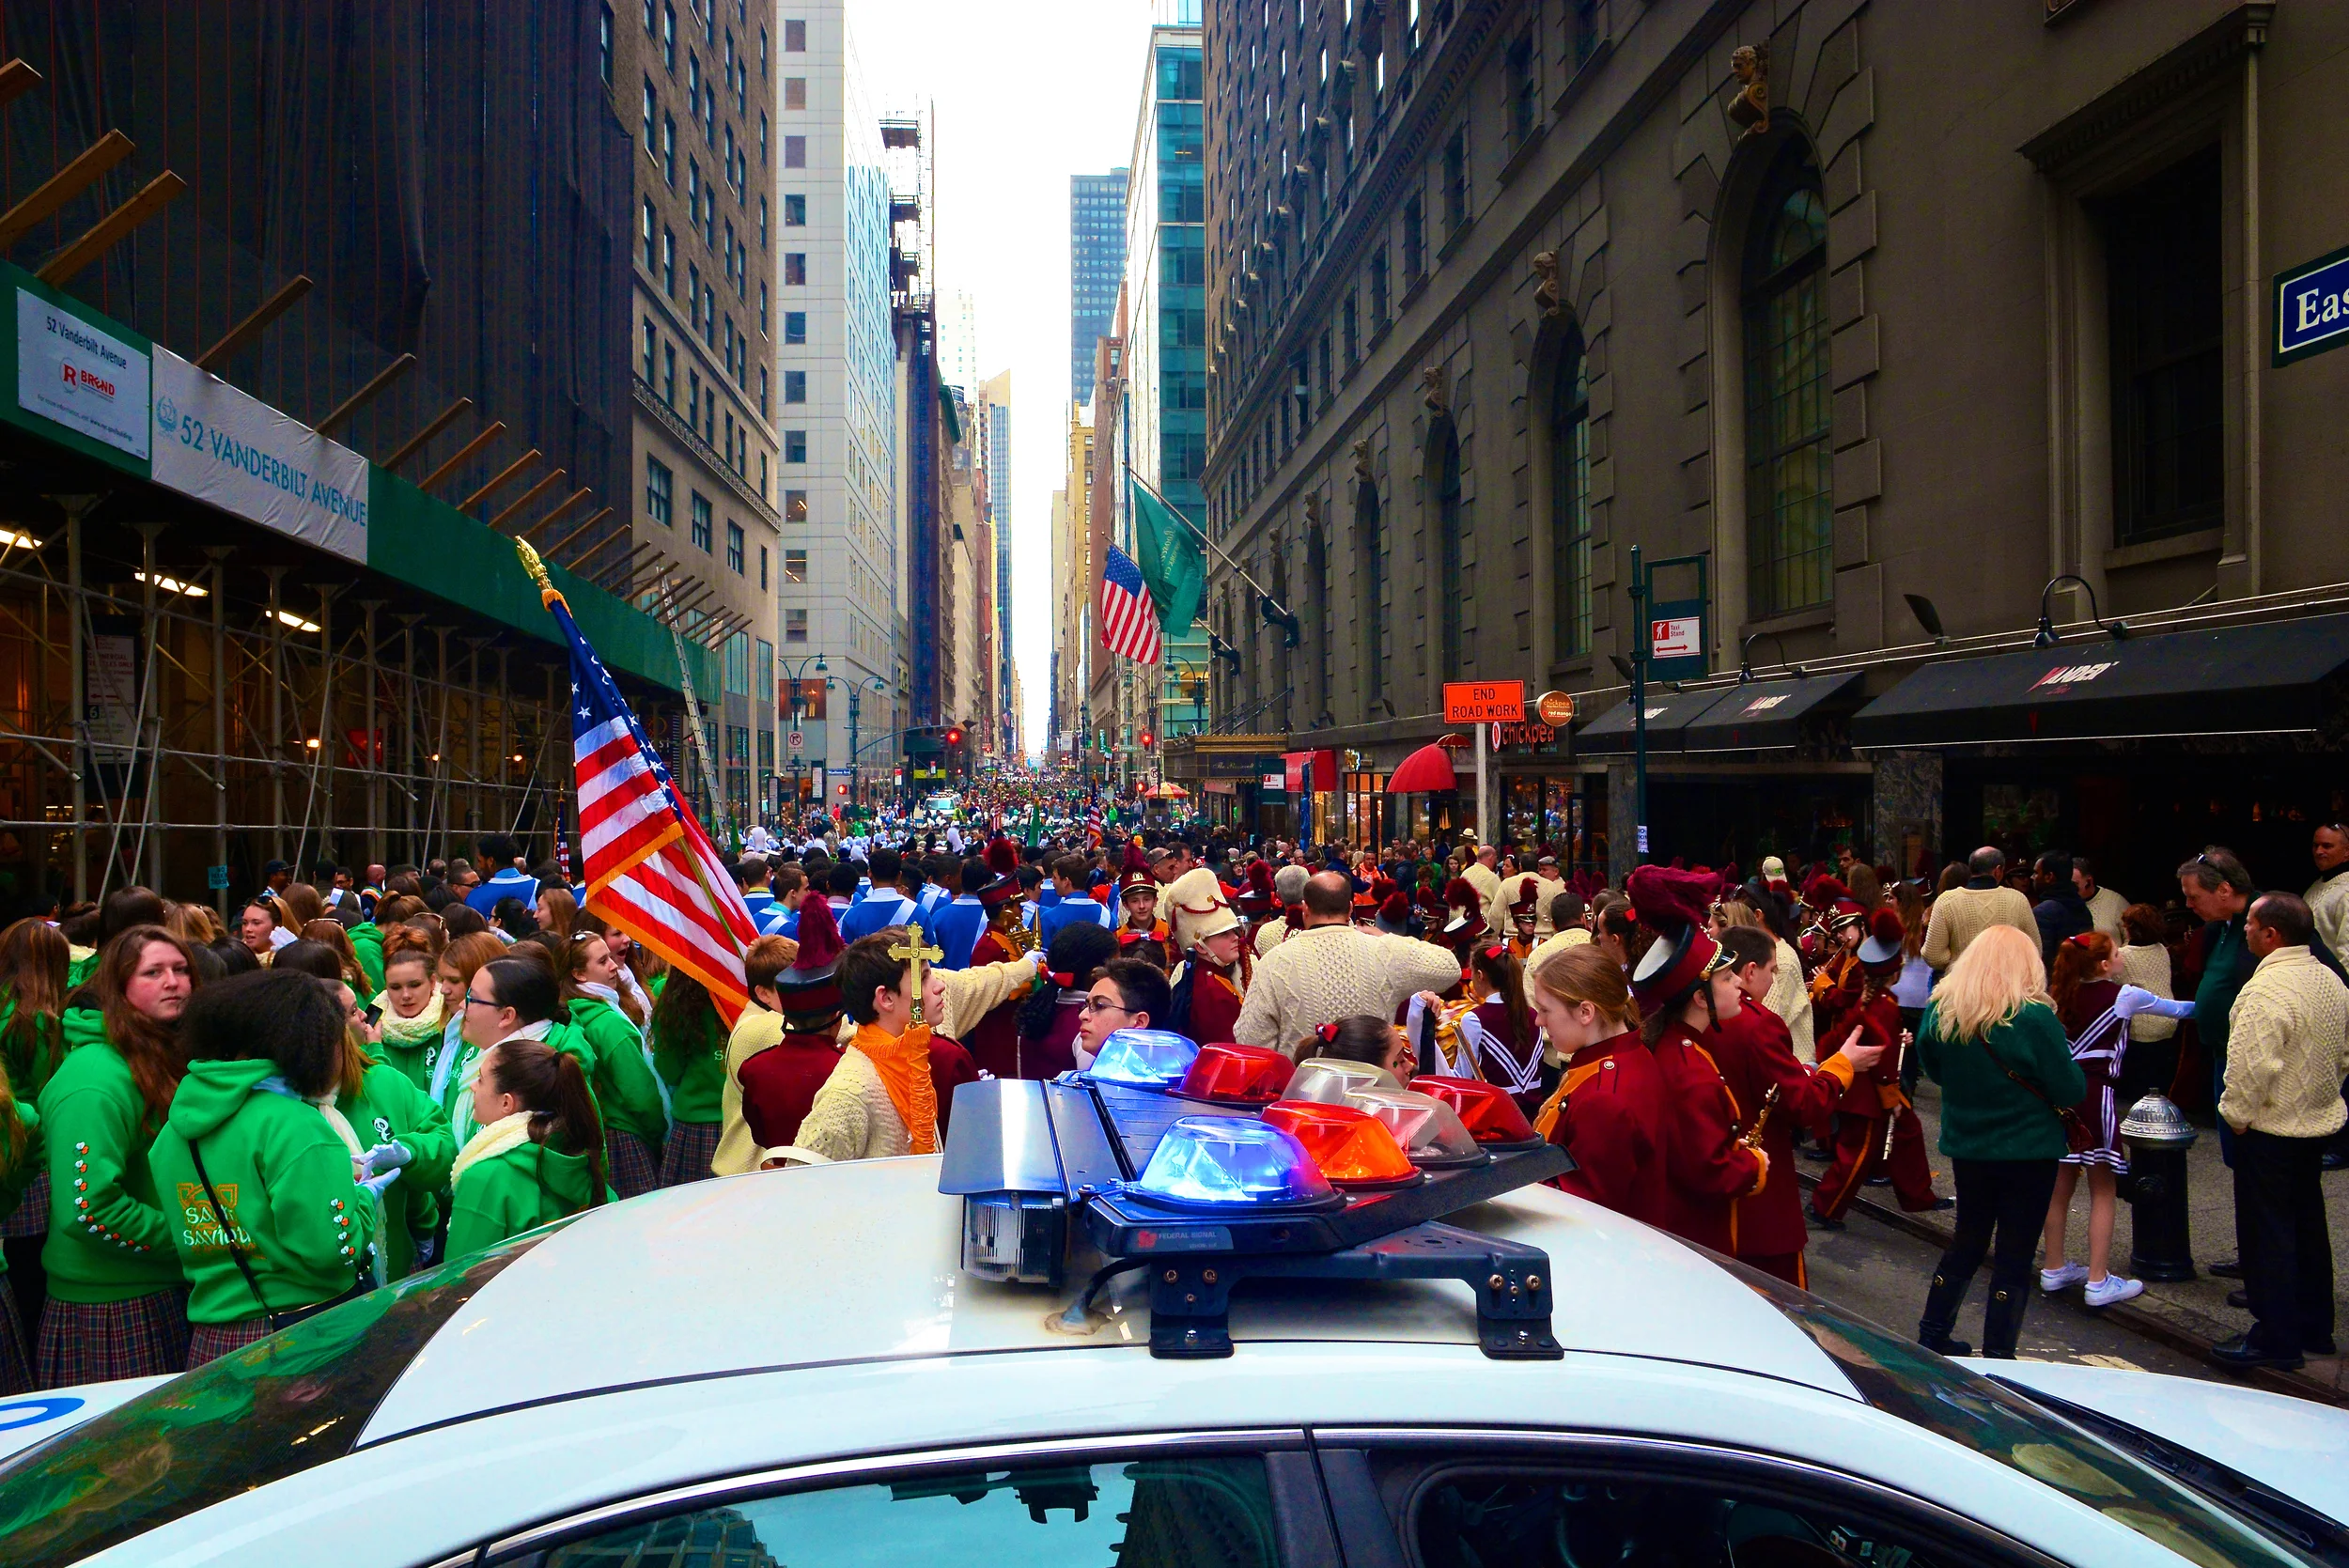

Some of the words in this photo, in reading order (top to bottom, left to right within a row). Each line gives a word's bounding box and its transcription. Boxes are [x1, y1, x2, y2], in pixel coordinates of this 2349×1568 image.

[46, 316, 56, 334] 52
[58, 321, 99, 355] Vanderbilt
[100, 345, 127, 369] Avenue
[180, 414, 204, 452] 52
[210, 427, 308, 499] VANDERBILT
[311, 480, 366, 527] AVENUE
[1473, 688, 1496, 701] END
[1452, 705, 1483, 718] ROAD
[1486, 704, 1518, 717] WORK
[1501, 716, 1556, 755] chickpea
[1159, 1232, 1190, 1240] FEDERAL
